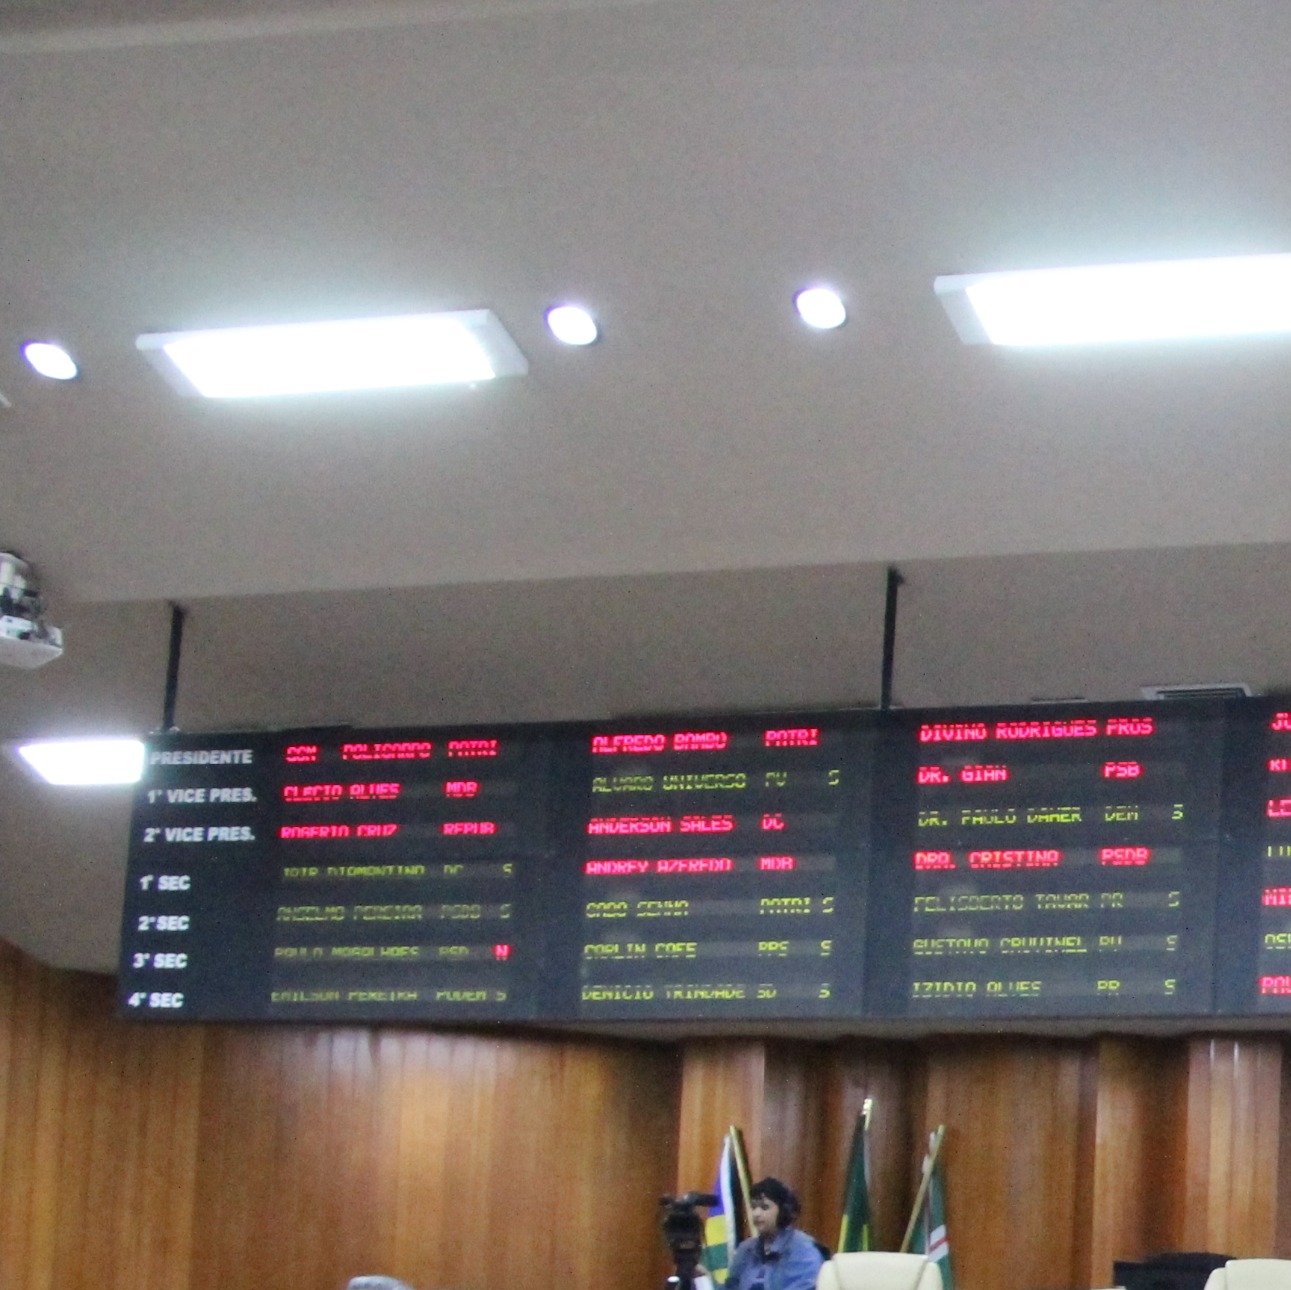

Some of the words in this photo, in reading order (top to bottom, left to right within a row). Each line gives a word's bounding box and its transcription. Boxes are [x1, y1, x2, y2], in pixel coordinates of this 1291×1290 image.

[149, 749, 253, 765] PRESIDENTE
[167, 788, 206, 803] VICE
[209, 787, 258, 802] PRES.
[165, 827, 205, 842] VICE
[207, 826, 256, 841] PRES.
[158, 875, 191, 891] SEC
[156, 915, 190, 931] SEC
[153, 952, 188, 969] SEC
[495, 944, 508, 961] N
[149, 992, 184, 1008] SEC
